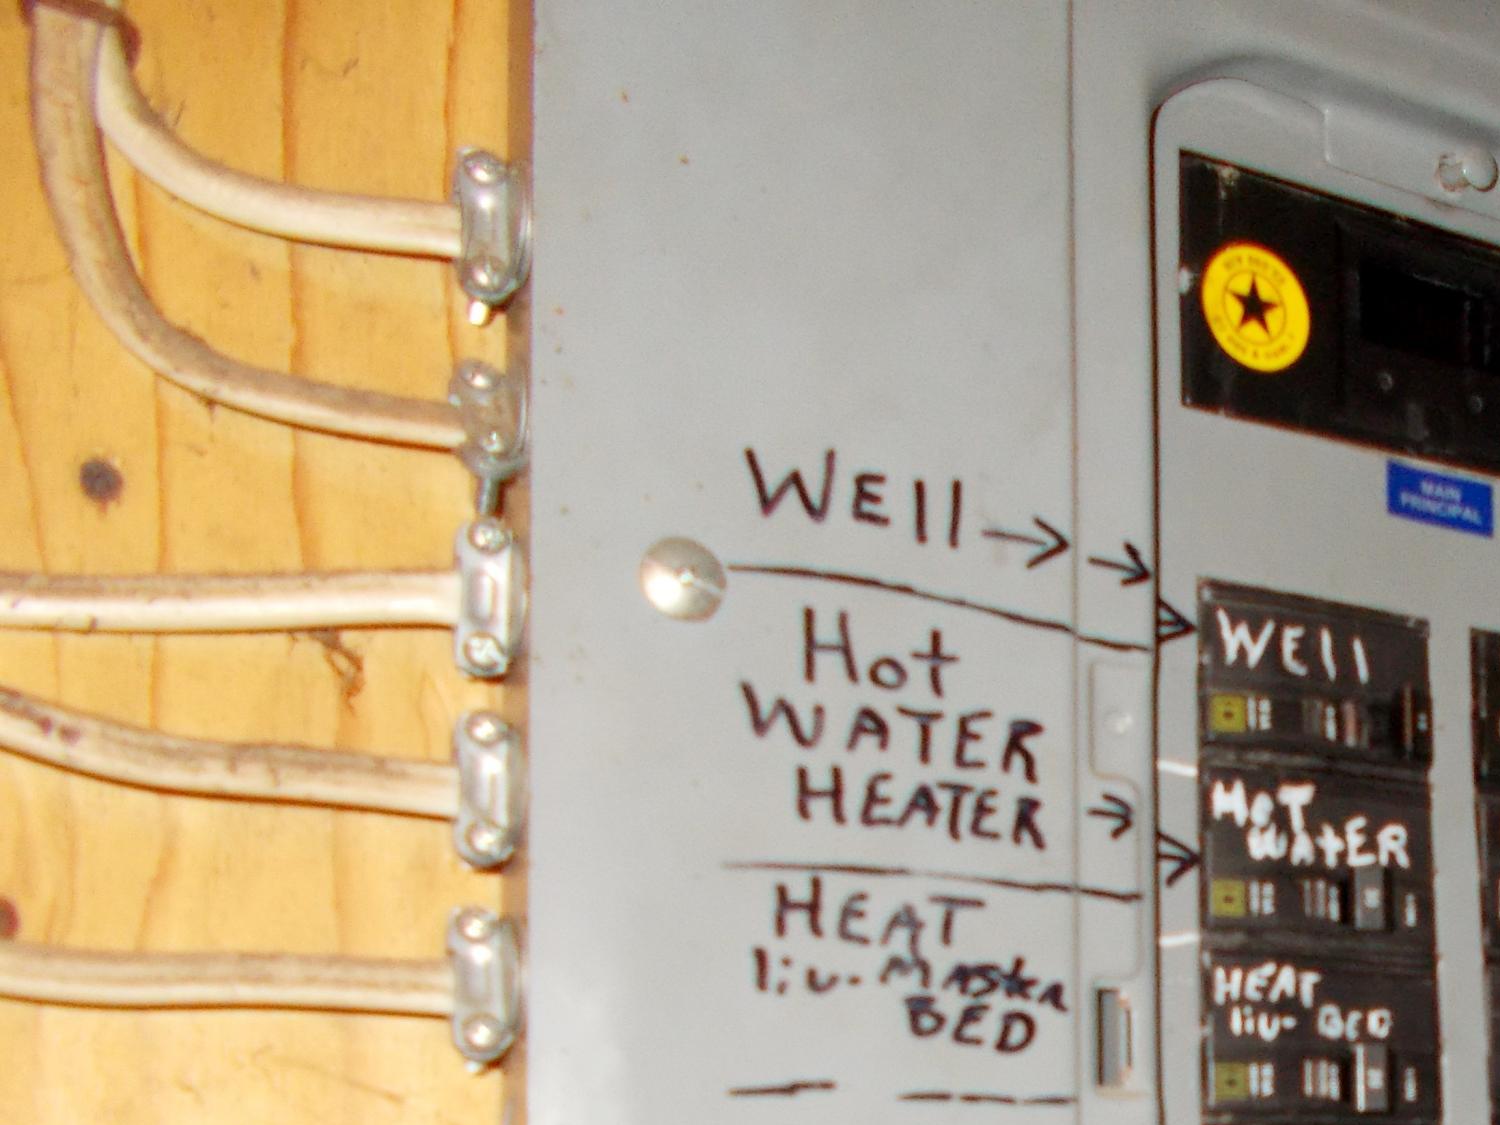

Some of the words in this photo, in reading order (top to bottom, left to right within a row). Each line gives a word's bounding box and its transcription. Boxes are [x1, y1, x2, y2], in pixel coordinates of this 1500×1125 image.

[1400, 491, 1483, 526] PRINCIPAL
[1421, 480, 1461, 504] MAIN
[803, 605, 960, 697] Hot
[740, 680, 1045, 785] WATER
[795, 763, 1048, 851] HEATER
[774, 873, 986, 946] HEAT
[1212, 960, 1323, 1009] HEAT
[905, 996, 1037, 1054] BED
